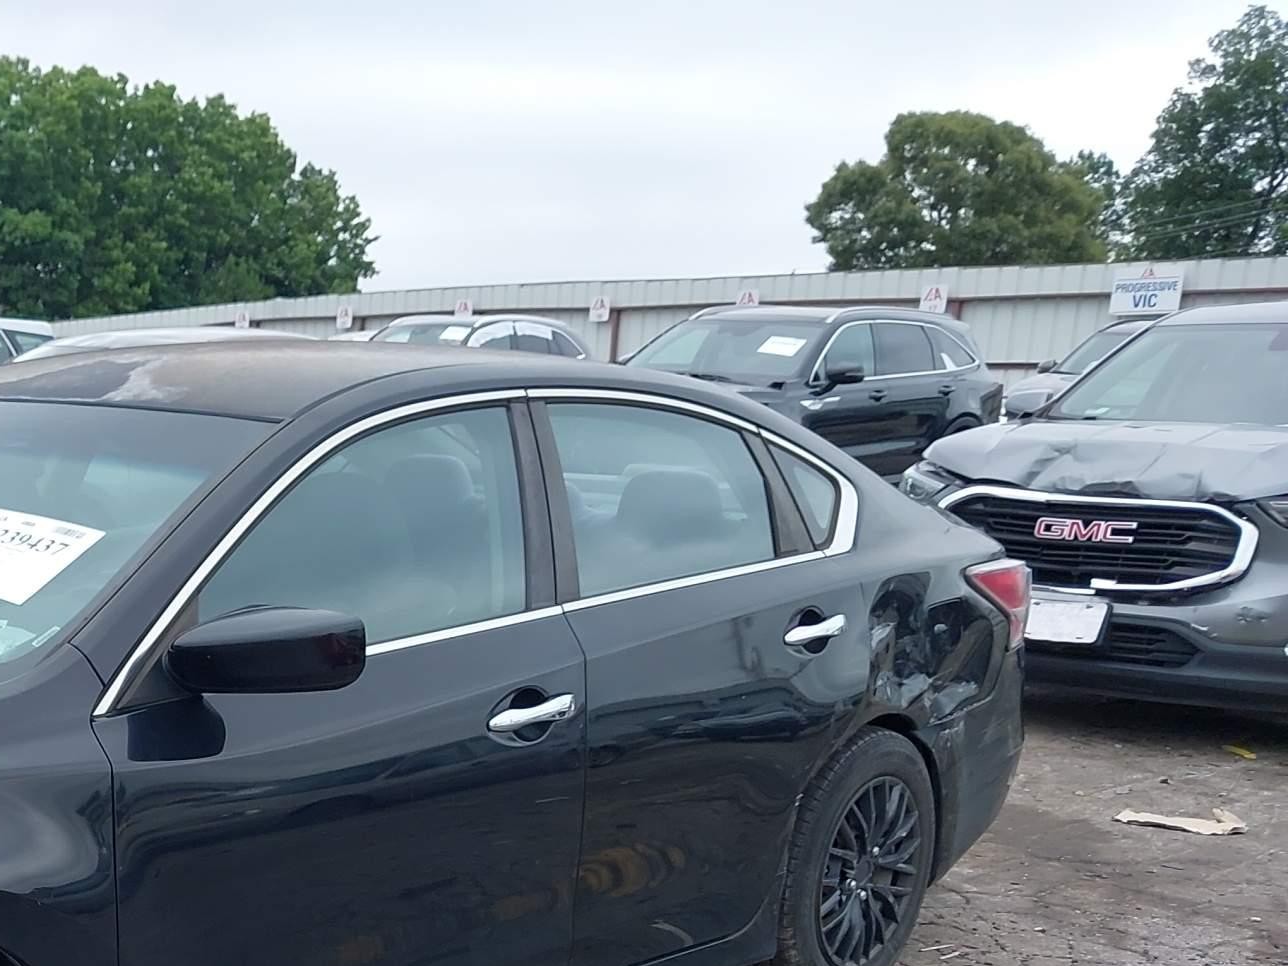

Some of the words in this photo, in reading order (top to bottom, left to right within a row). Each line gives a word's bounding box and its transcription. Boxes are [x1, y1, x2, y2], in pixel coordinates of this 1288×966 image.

[1114, 280, 1179, 294] PROGRESSIVE
[1132, 293, 1158, 308] VIC
[1034, 517, 1138, 543] GMC
